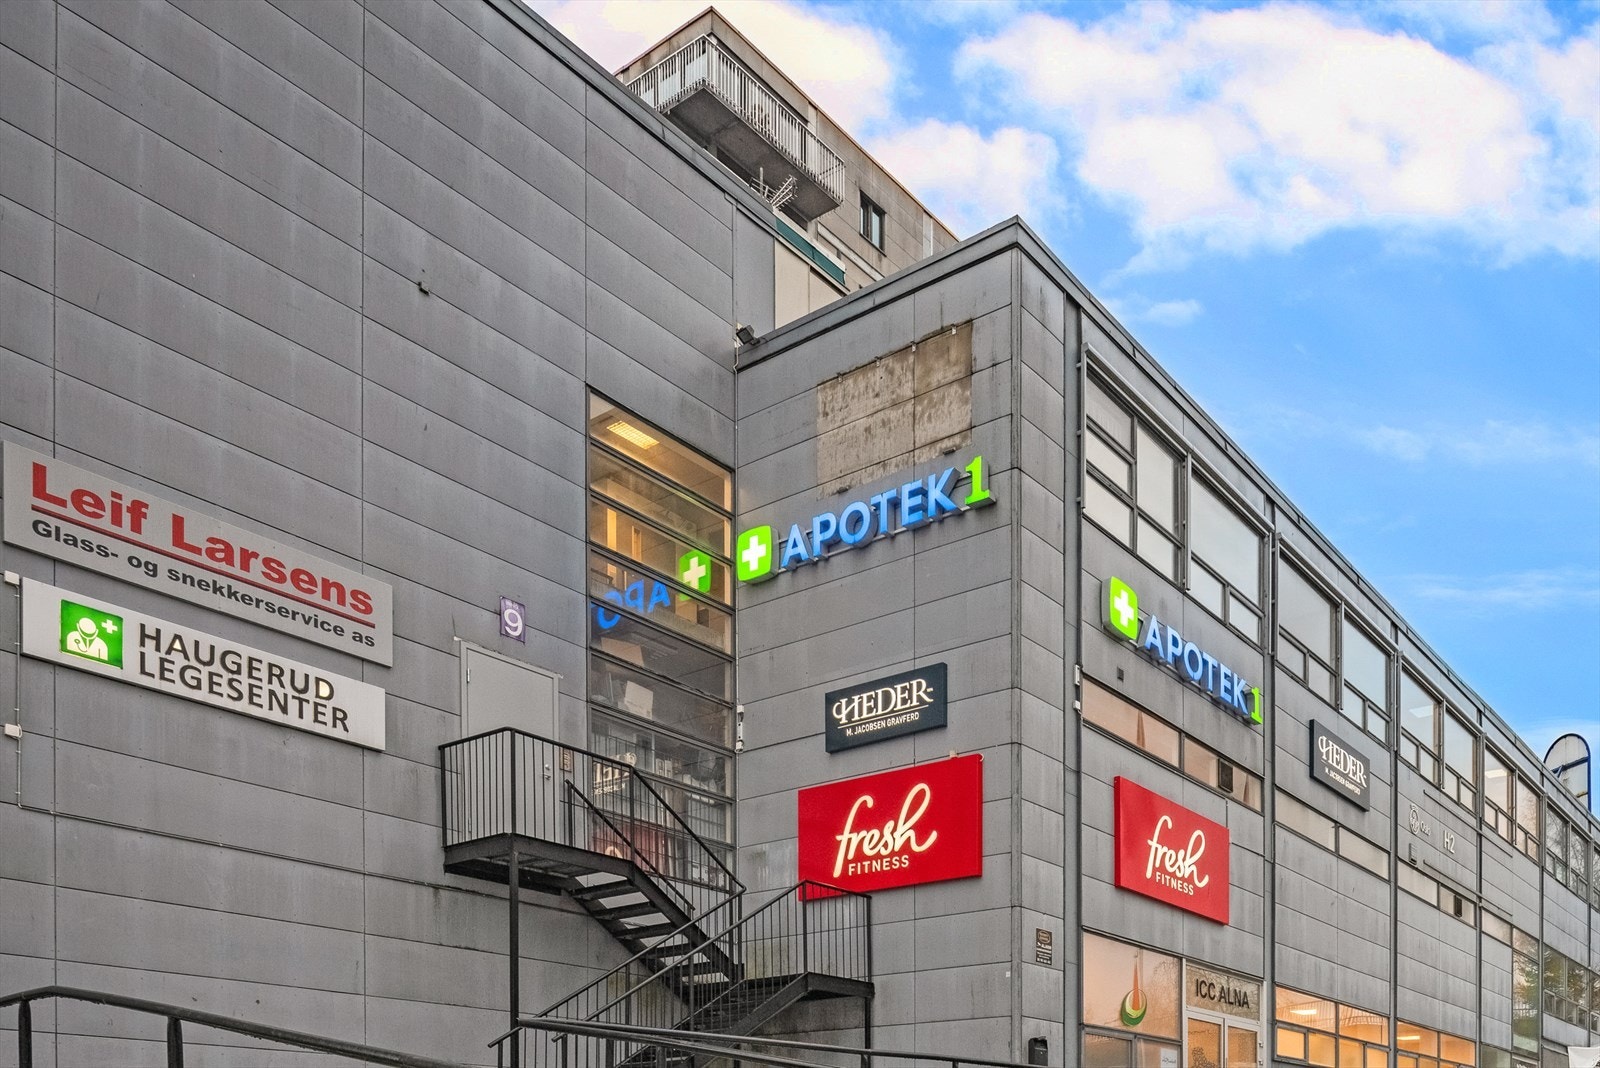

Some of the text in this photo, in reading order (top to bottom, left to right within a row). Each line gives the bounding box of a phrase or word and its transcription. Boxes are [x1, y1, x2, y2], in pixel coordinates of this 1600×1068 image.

[32, 461, 374, 616] Leif Larsens
[781, 455, 993, 569] APOTEK 1
[31, 519, 376, 648] Glass- og snekkerservice as
[503, 608, 523, 637] 9
[138, 622, 336, 703] HAUGERUD
[138, 650, 350, 733] LEGESENTER
[1144, 614, 1263, 726] APOTEK 1
[846, 711, 920, 737] M. JACOBSEN GRAVFERD
[832, 782, 938, 878] fresh
[848, 854, 910, 876] FITNESS
[1145, 814, 1210, 888] fresh
[1443, 829, 1456, 855] H2
[1155, 870, 1195, 897] FITNESS
[1195, 978, 1251, 1009] ICC ALNA
